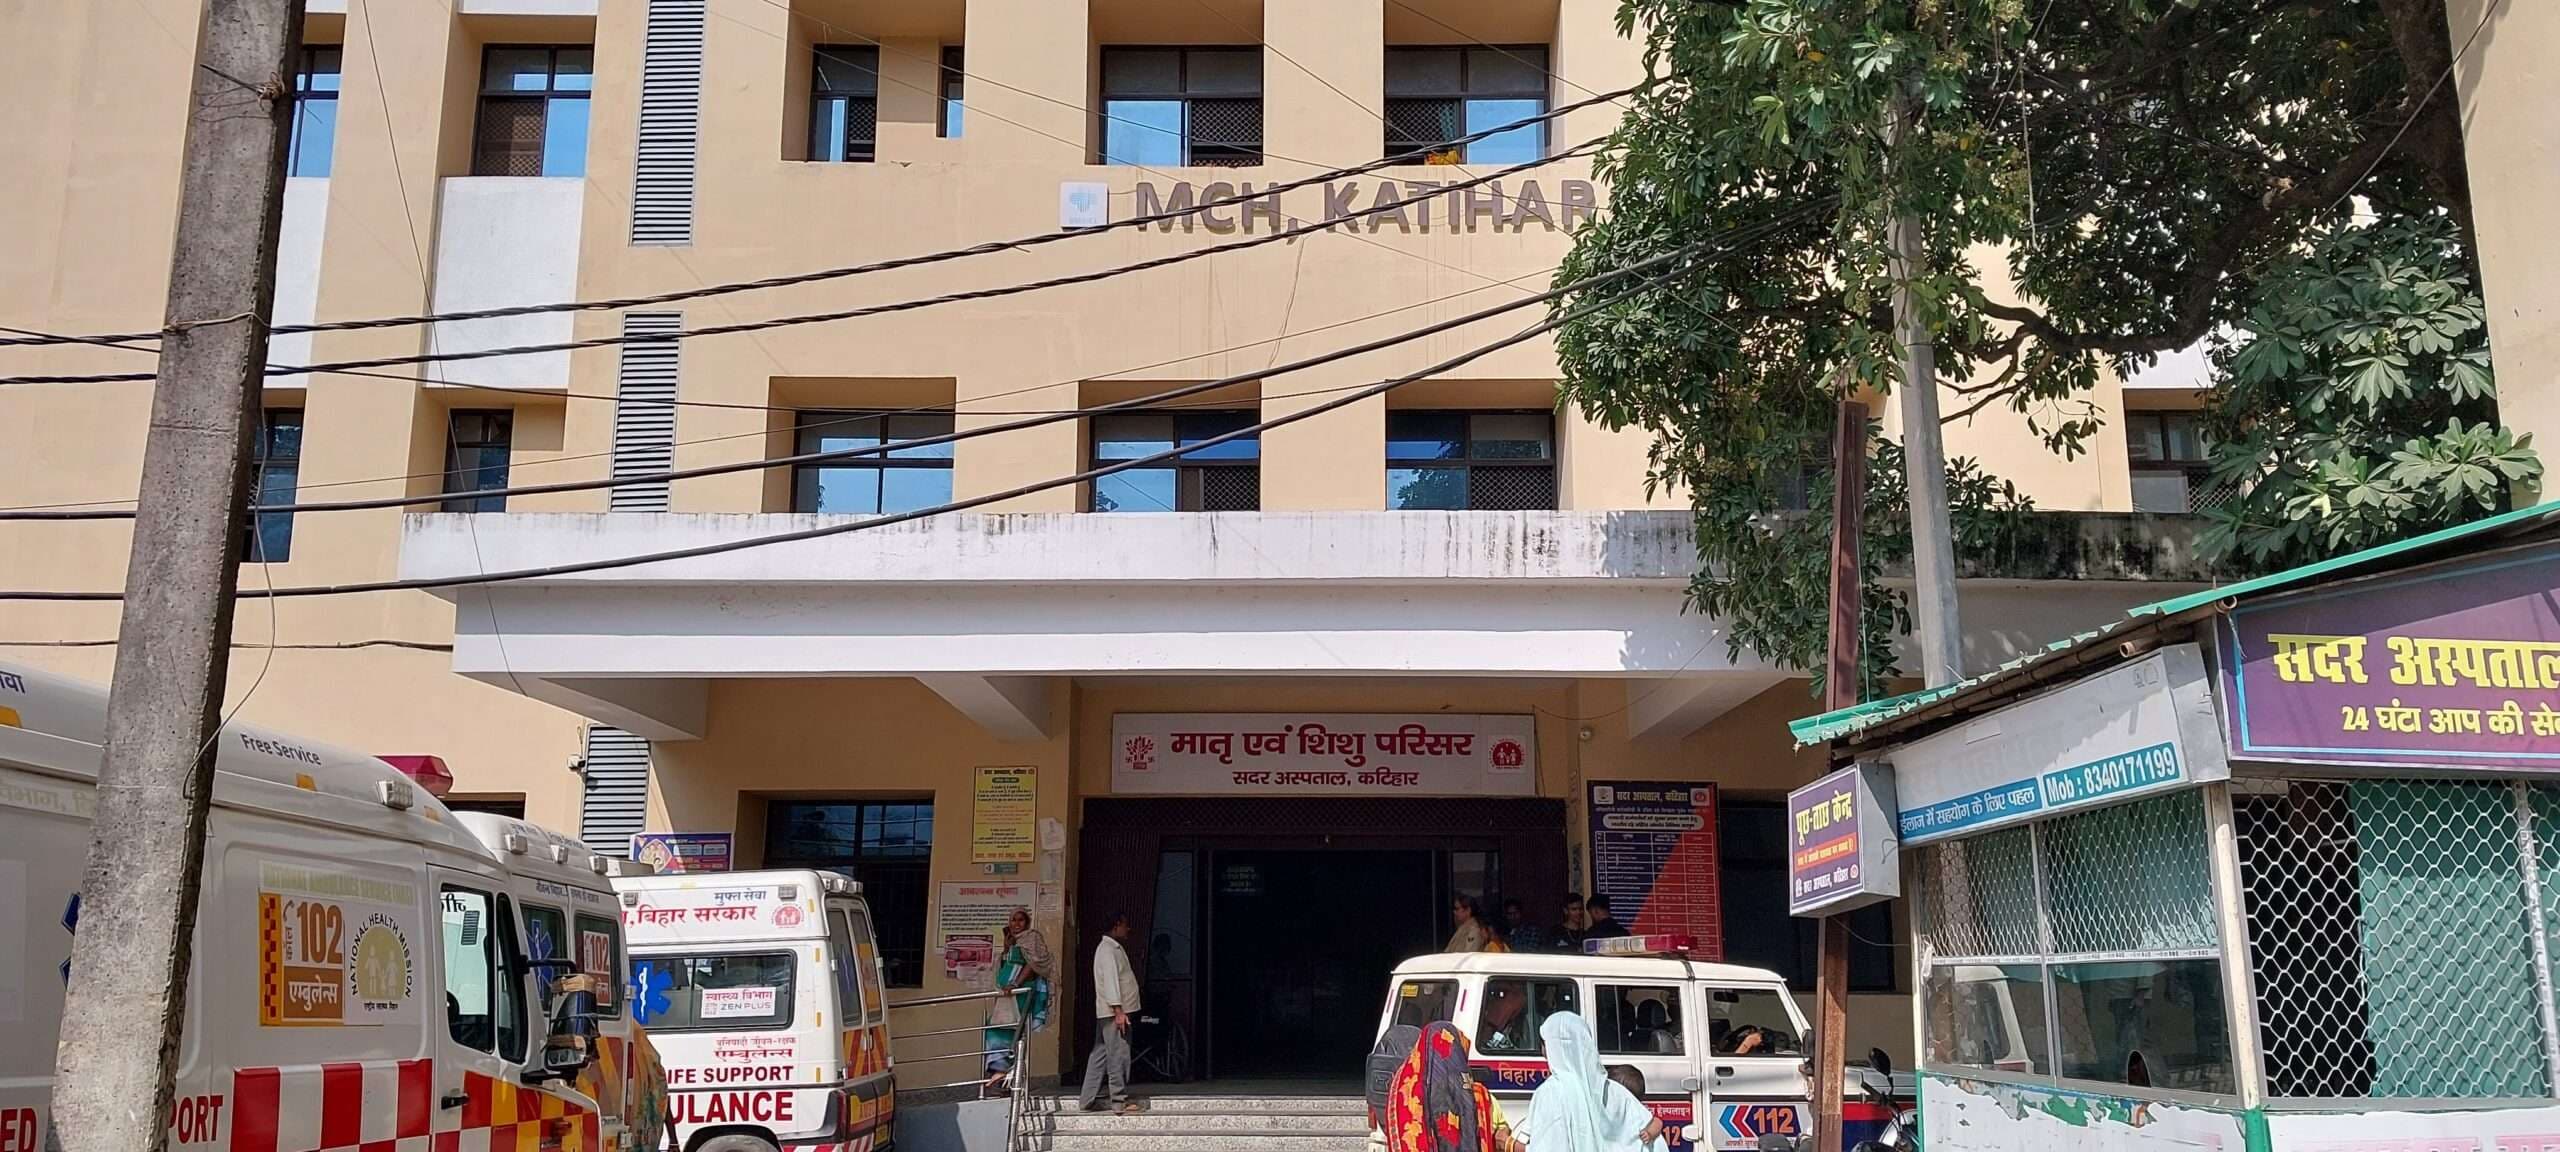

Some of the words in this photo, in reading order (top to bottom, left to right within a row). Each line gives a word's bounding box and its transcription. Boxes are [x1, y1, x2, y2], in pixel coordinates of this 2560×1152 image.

[1135, 181, 1299, 244] MCH,
[1323, 180, 1597, 235] KATIHAR
[2266, 633, 2369, 684] सदर
[2341, 706, 2370, 731] 24
[2375, 698, 2422, 733] घंटा
[2428, 709, 2481, 735] आप
[2486, 700, 2525, 736] की
[240, 733, 273, 756] Free
[273, 739, 322, 768] Service
[1170, 732, 1234, 765] मातृ
[1242, 724, 1294, 757] एवं
[1298, 723, 1368, 768] शिशु
[1376, 723, 1475, 757] परिसर
[1232, 770, 1270, 786] सदर
[1274, 769, 1352, 788] अस्पताल,
[1358, 765, 1420, 787] कटिहार
[2046, 771, 2075, 803] Mob
[2083, 746, 2177, 794] 8340171199
[1936, 800, 1971, 825] सहयोग
[1972, 795, 1984, 816] के
[1984, 792, 2007, 813] लिए
[2007, 786, 2035, 807] पहल
[743, 887, 767, 901] सेवा
[296, 901, 343, 964] 102
[637, 904, 686, 928] बिहार
[694, 905, 758, 922] सरकार
[349, 921, 370, 997] NATIONAL
[368, 912, 399, 937] HEALTH
[398, 932, 415, 998] MISSION
[592, 935, 610, 972] 102
[287, 975, 339, 1012] एम्बुलेन्स
[720, 1003, 743, 1011] ZEN
[744, 1002, 772, 1010] PLUS
[667, 1068, 697, 1084] IFE
[703, 1065, 794, 1083] SUPPORT
[1497, 1063, 1537, 1087] बिहार
[668, 1091, 794, 1125] ULANCE
[1753, 1107, 1795, 1134] 112
[1663, 1126, 1681, 1147] 12
